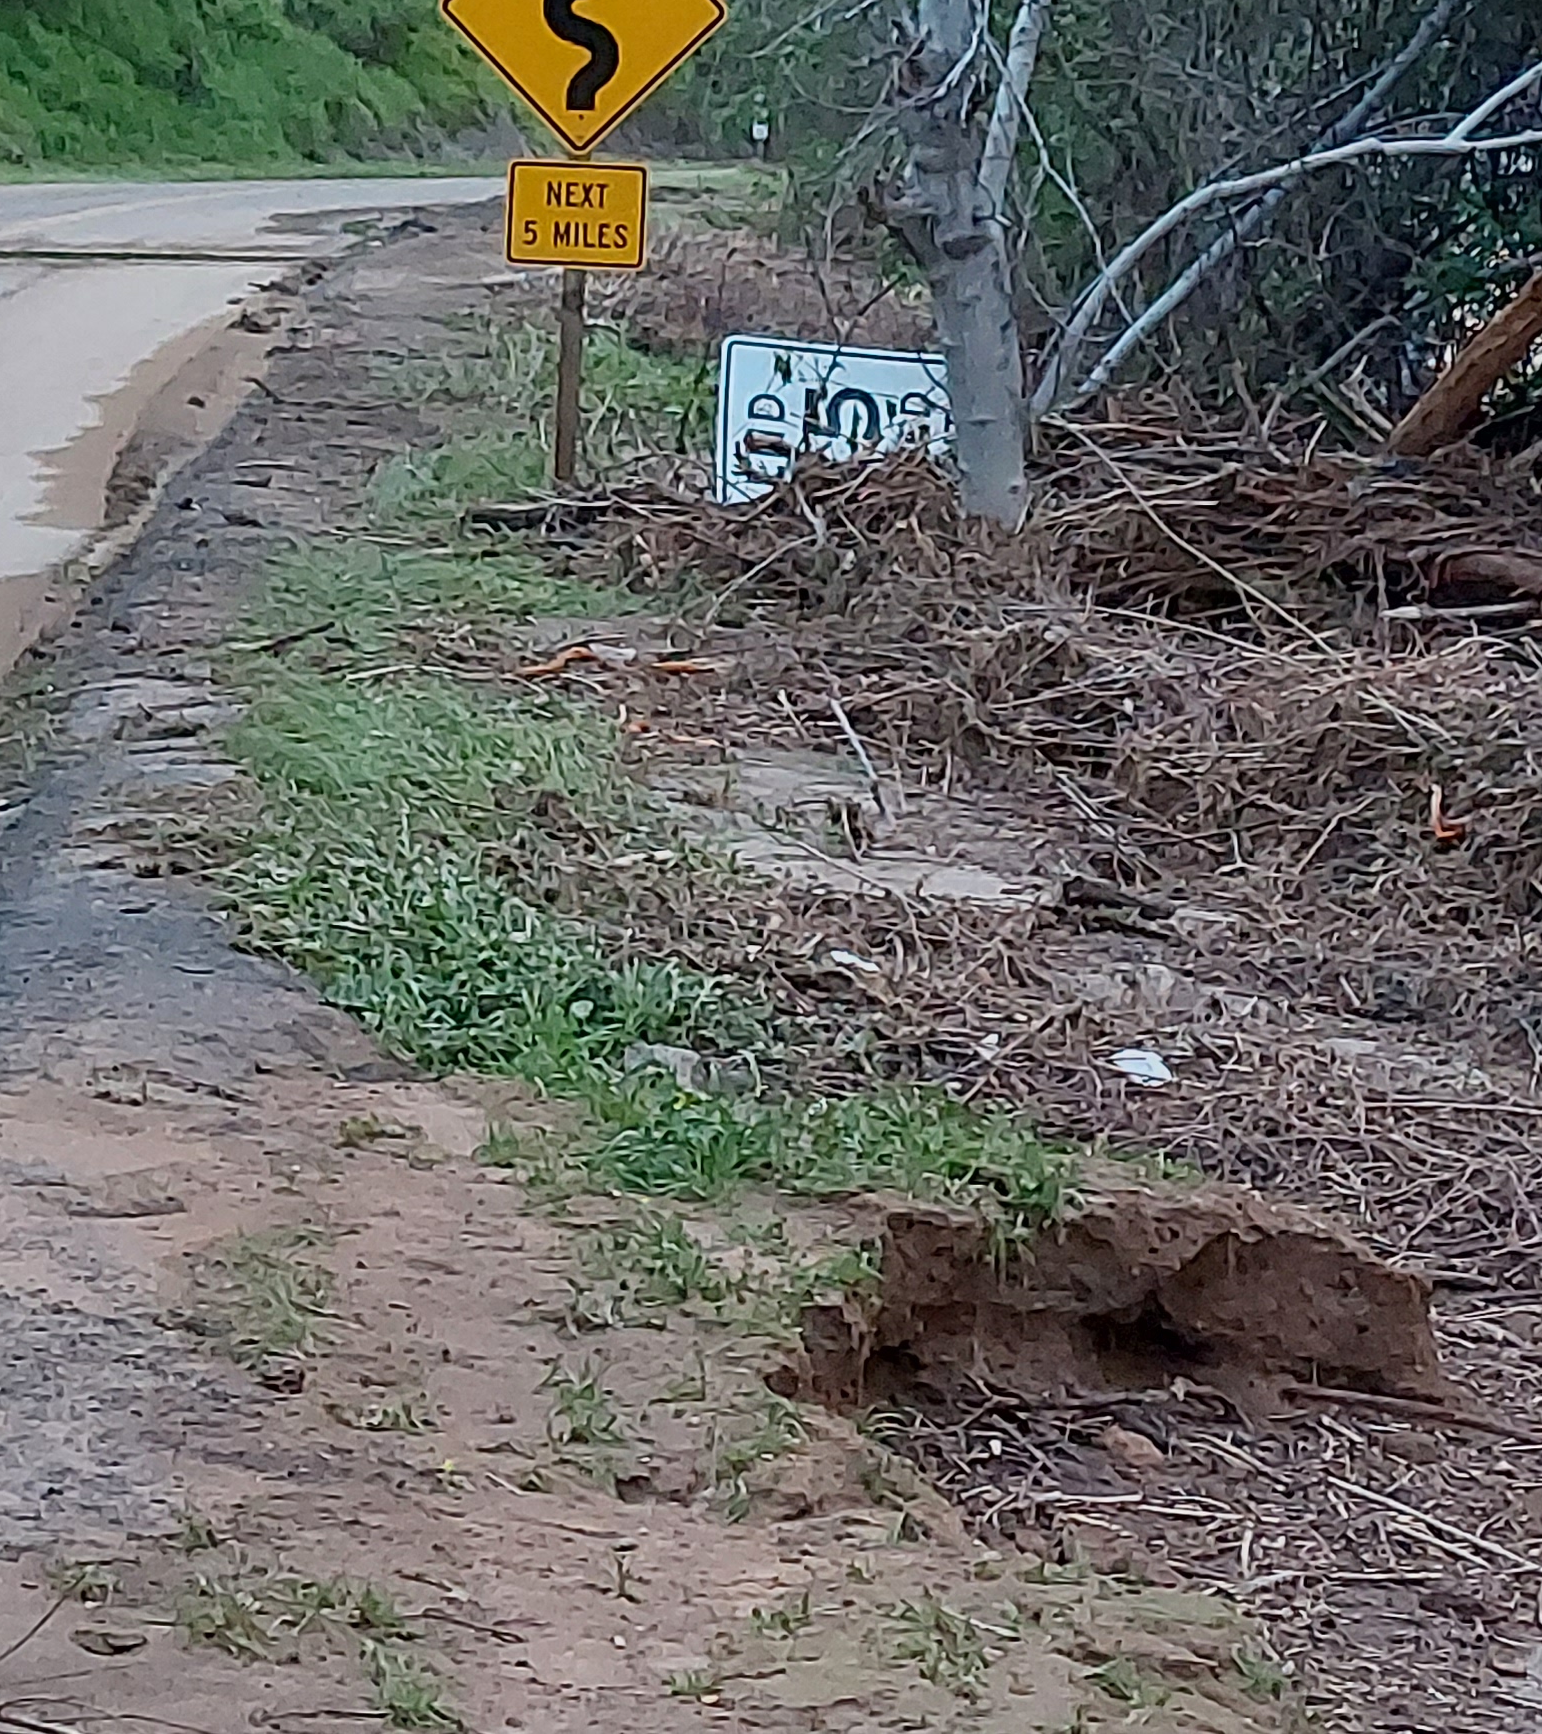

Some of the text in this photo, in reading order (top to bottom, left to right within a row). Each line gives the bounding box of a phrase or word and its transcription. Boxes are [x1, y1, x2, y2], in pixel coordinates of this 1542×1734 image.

[546, 180, 610, 209] NEXT
[522, 219, 629, 250] 5 MILES
